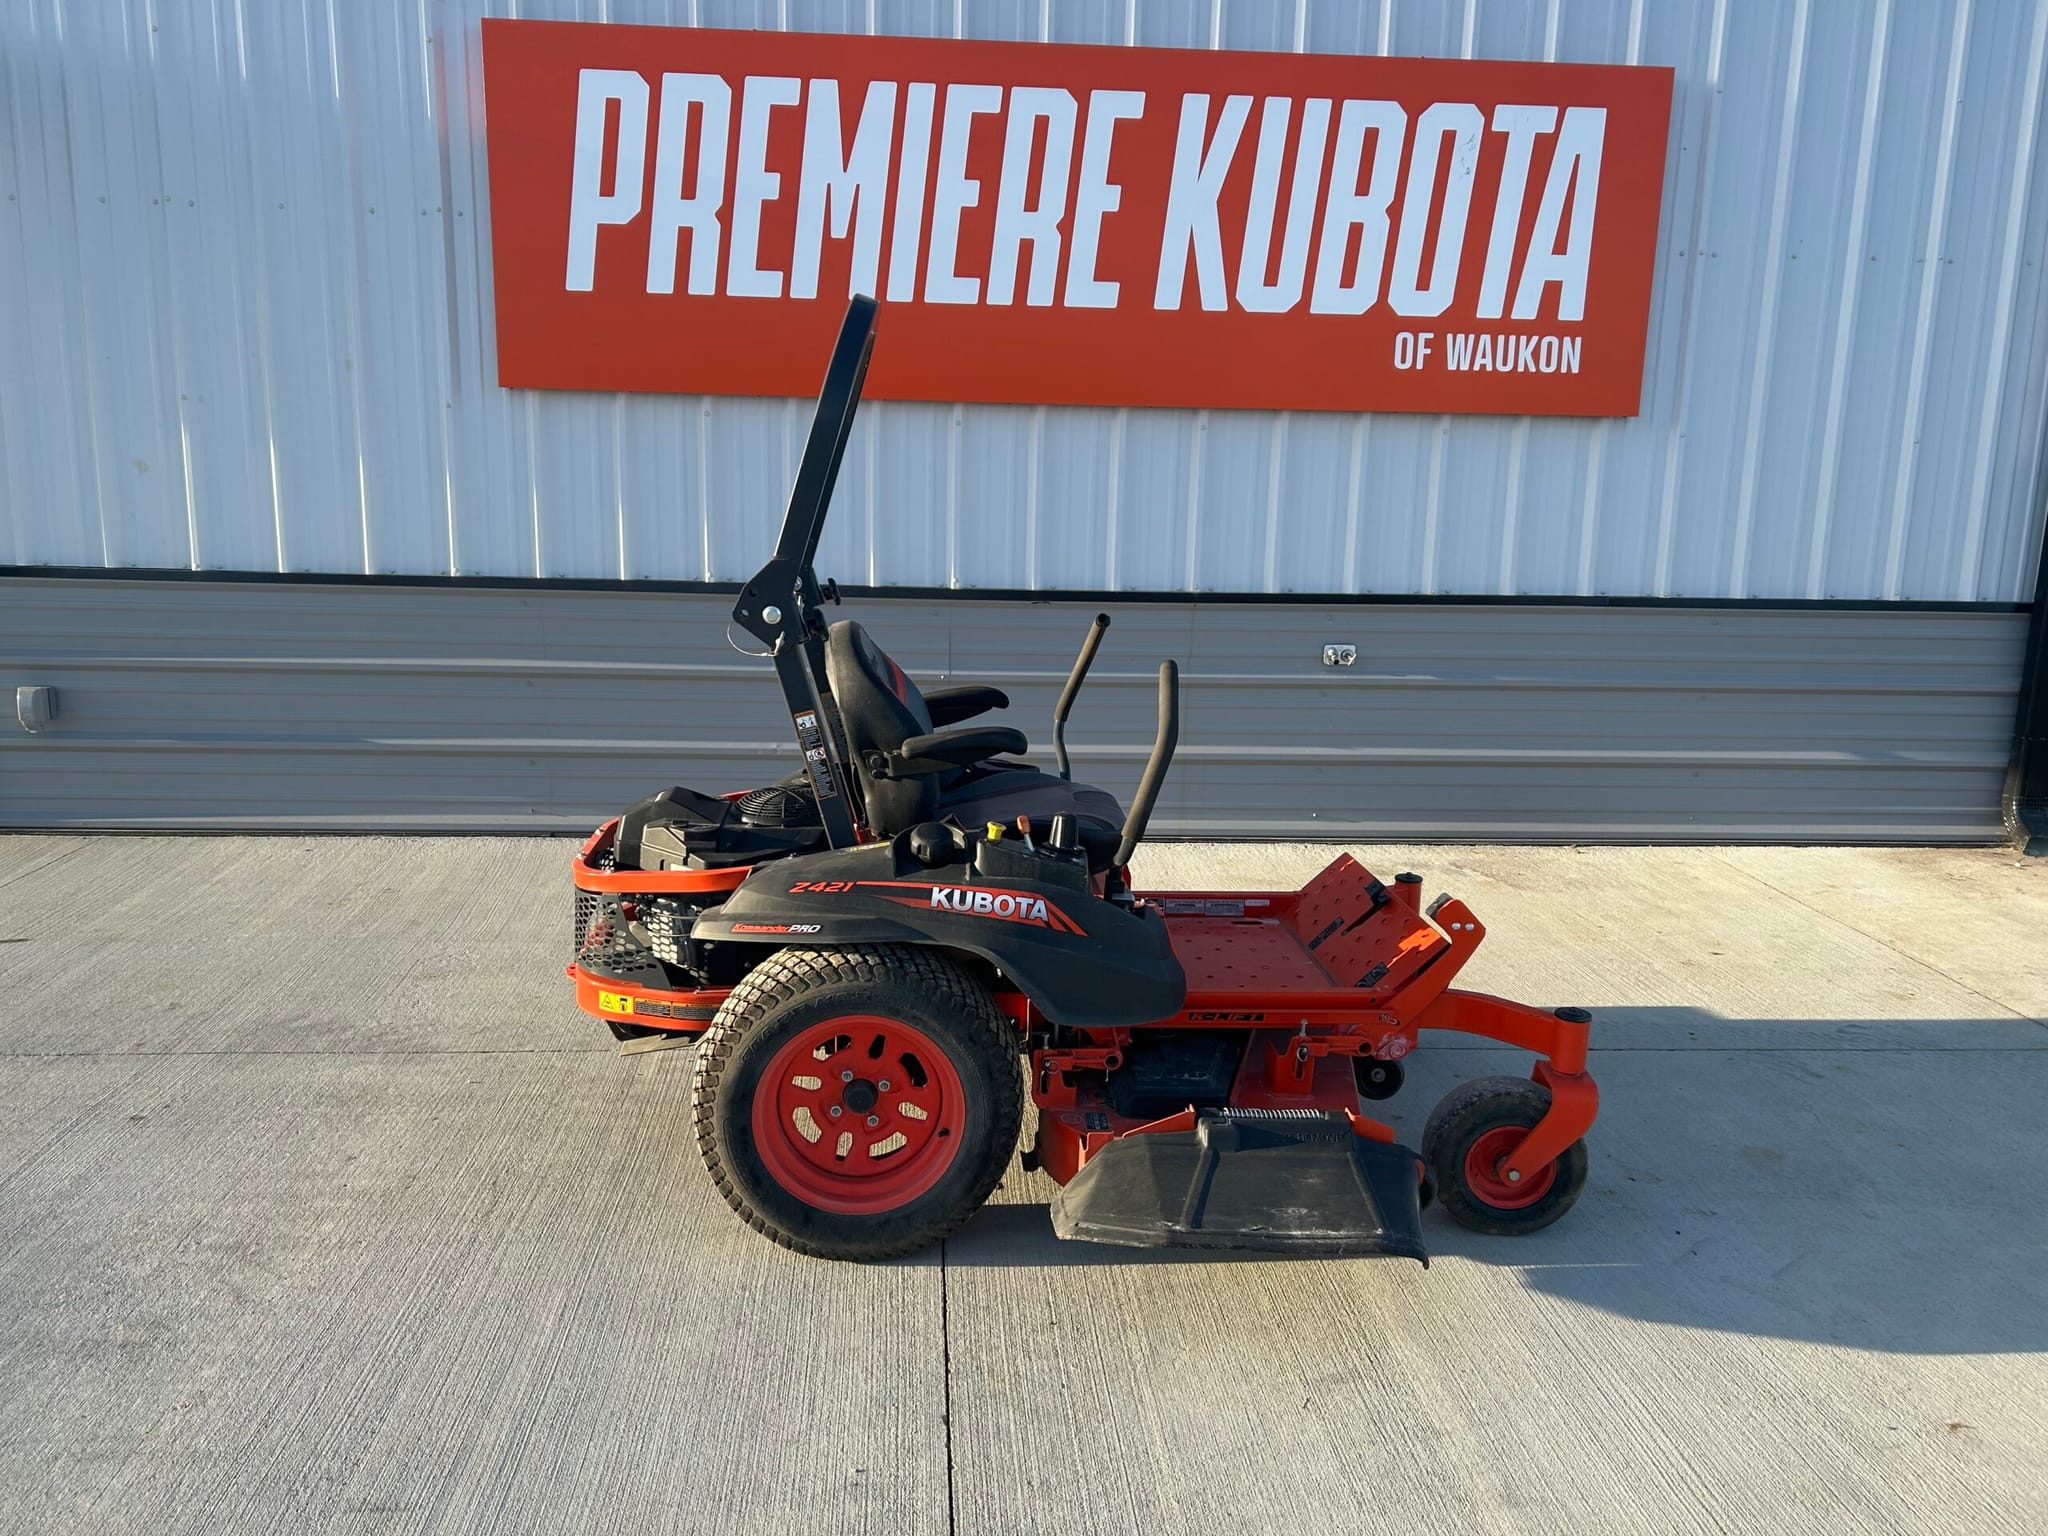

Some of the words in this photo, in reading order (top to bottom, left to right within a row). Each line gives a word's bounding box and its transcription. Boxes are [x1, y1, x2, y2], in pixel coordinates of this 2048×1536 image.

[565, 68, 1147, 309] PREMIERE
[1153, 92, 1608, 321] KUBOTA
[1393, 331, 1435, 370] OF
[1446, 332, 1583, 374] WAUKON
[789, 881, 856, 894] Z421
[929, 886, 1050, 922] KUBOTA
